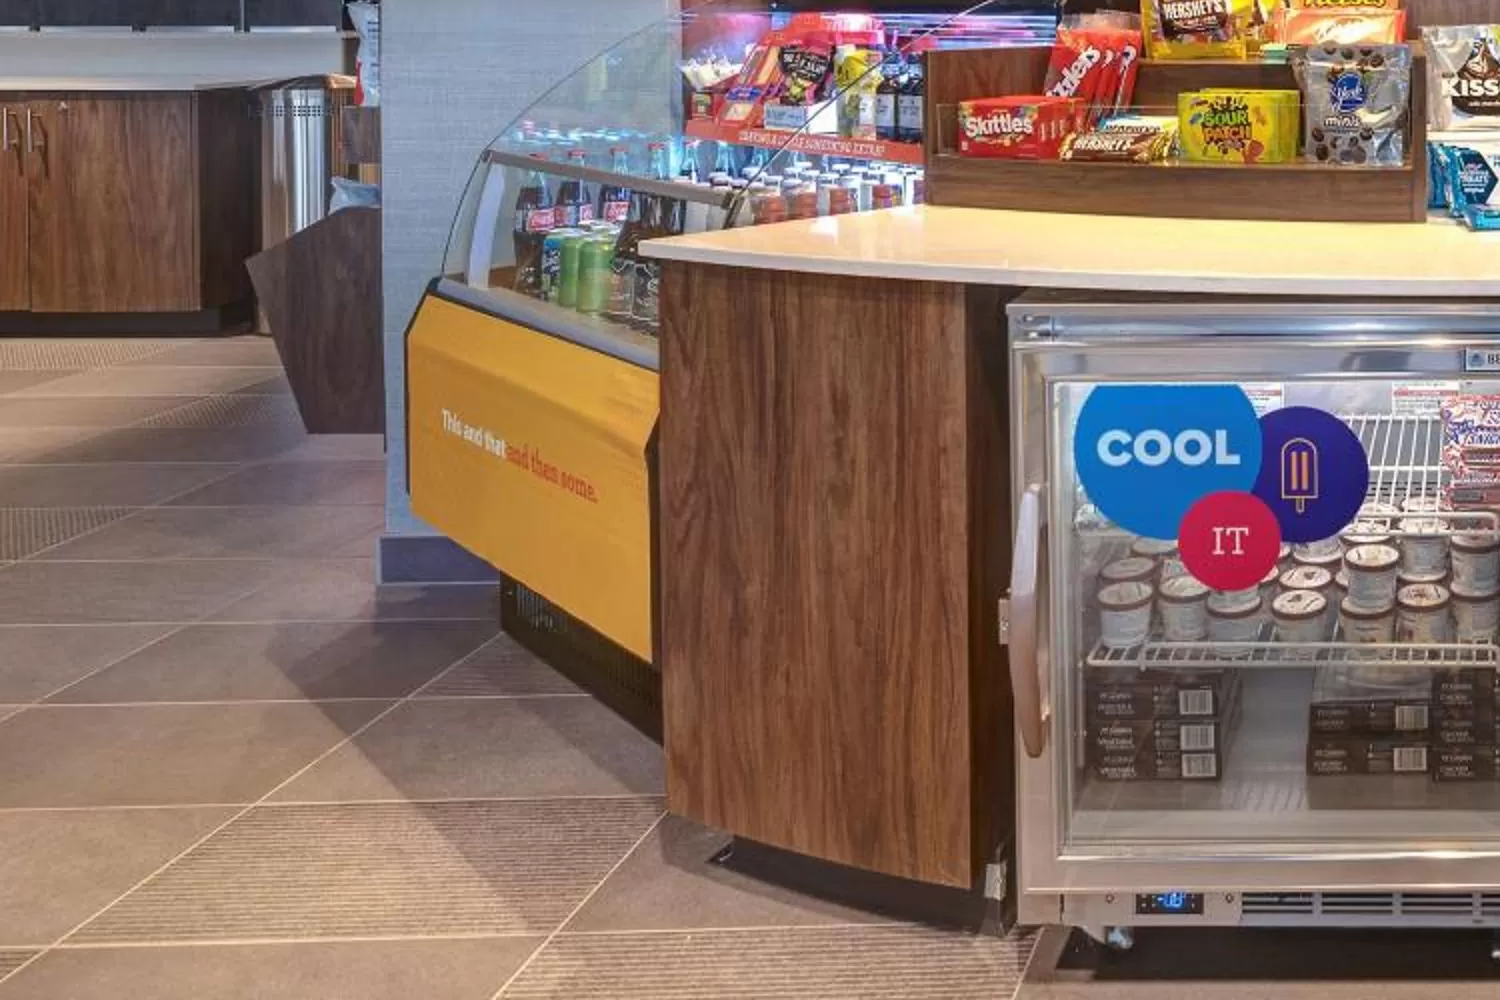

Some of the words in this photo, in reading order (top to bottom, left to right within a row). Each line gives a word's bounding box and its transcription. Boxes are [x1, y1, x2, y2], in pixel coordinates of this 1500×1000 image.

[965, 113, 1034, 138] Skittles
[1203, 110, 1248, 126] SOUR
[1204, 125, 1251, 142] PATCH
[1096, 429, 1242, 467] COOL
[1211, 526, 1250, 556] IT
